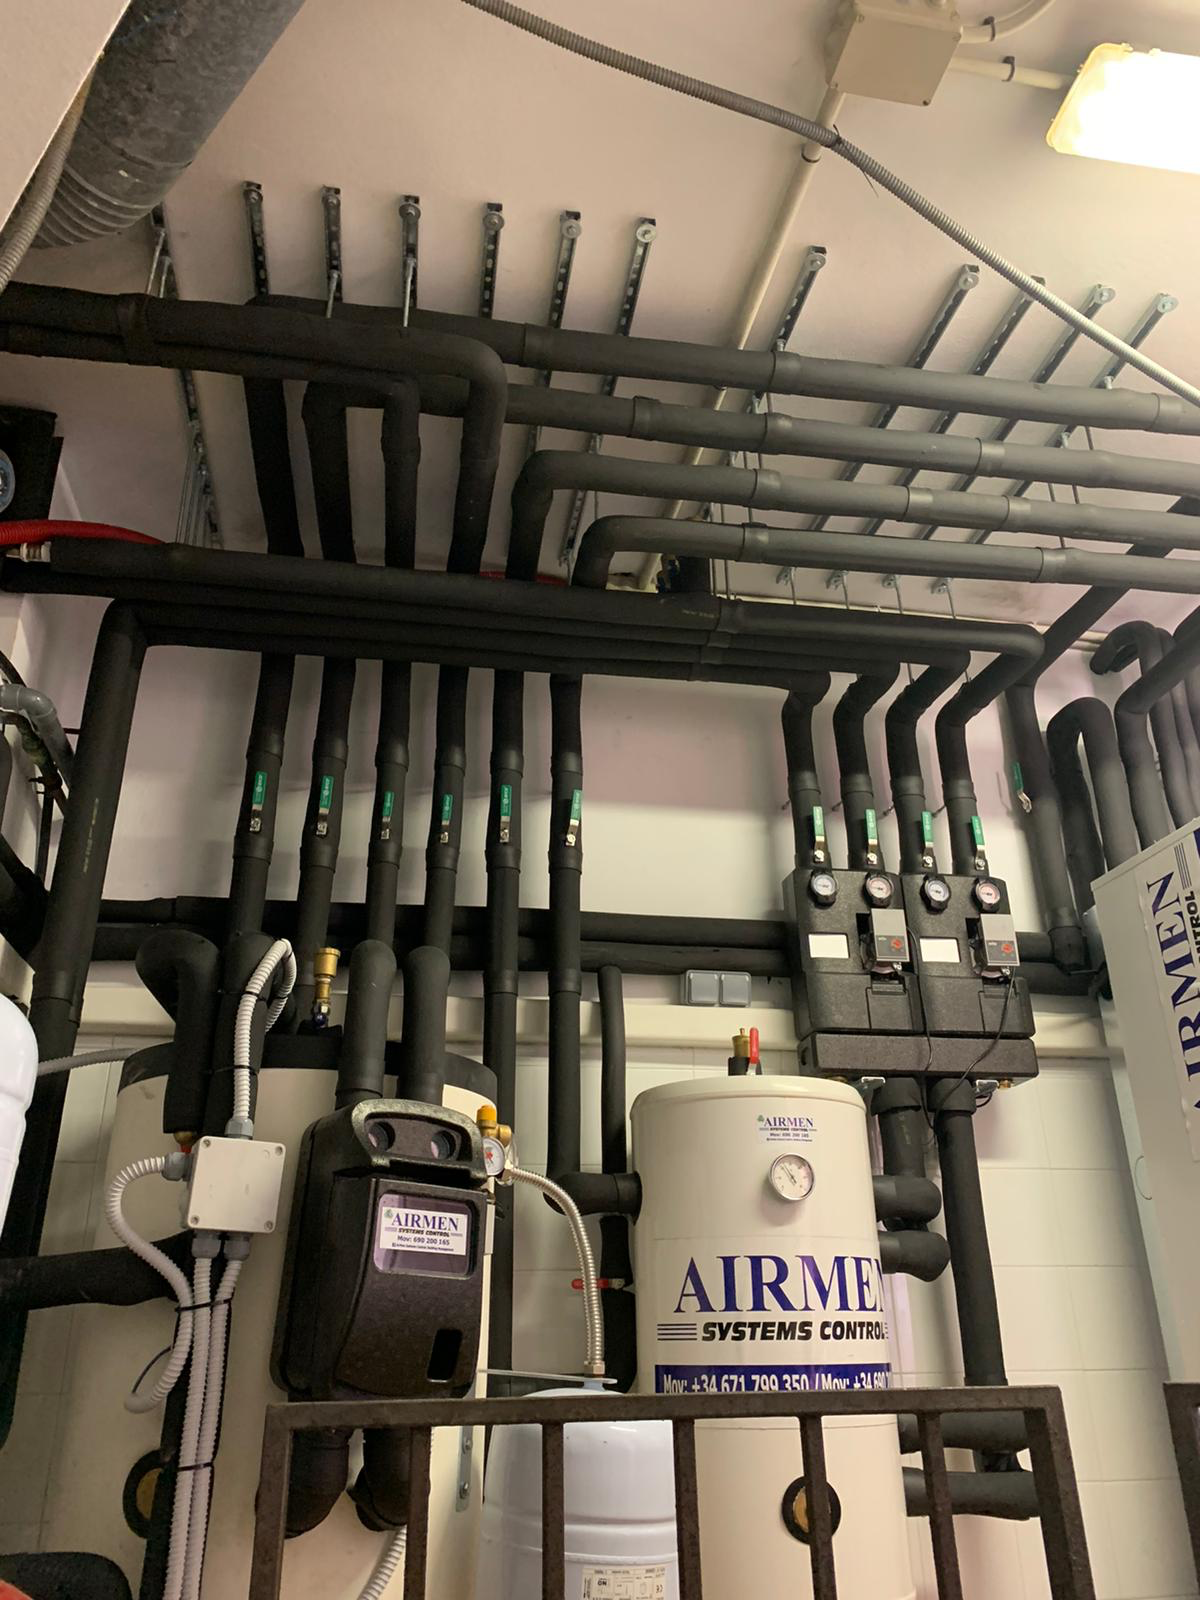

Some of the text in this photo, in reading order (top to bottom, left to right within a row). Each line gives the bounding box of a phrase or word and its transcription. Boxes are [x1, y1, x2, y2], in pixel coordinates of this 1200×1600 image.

[764, 1117, 813, 1127] AIRMEN
[392, 1213, 459, 1231] AIRMEN
[426, 1237, 438, 1245] 200
[701, 1320, 813, 1342] SYSTEMS
